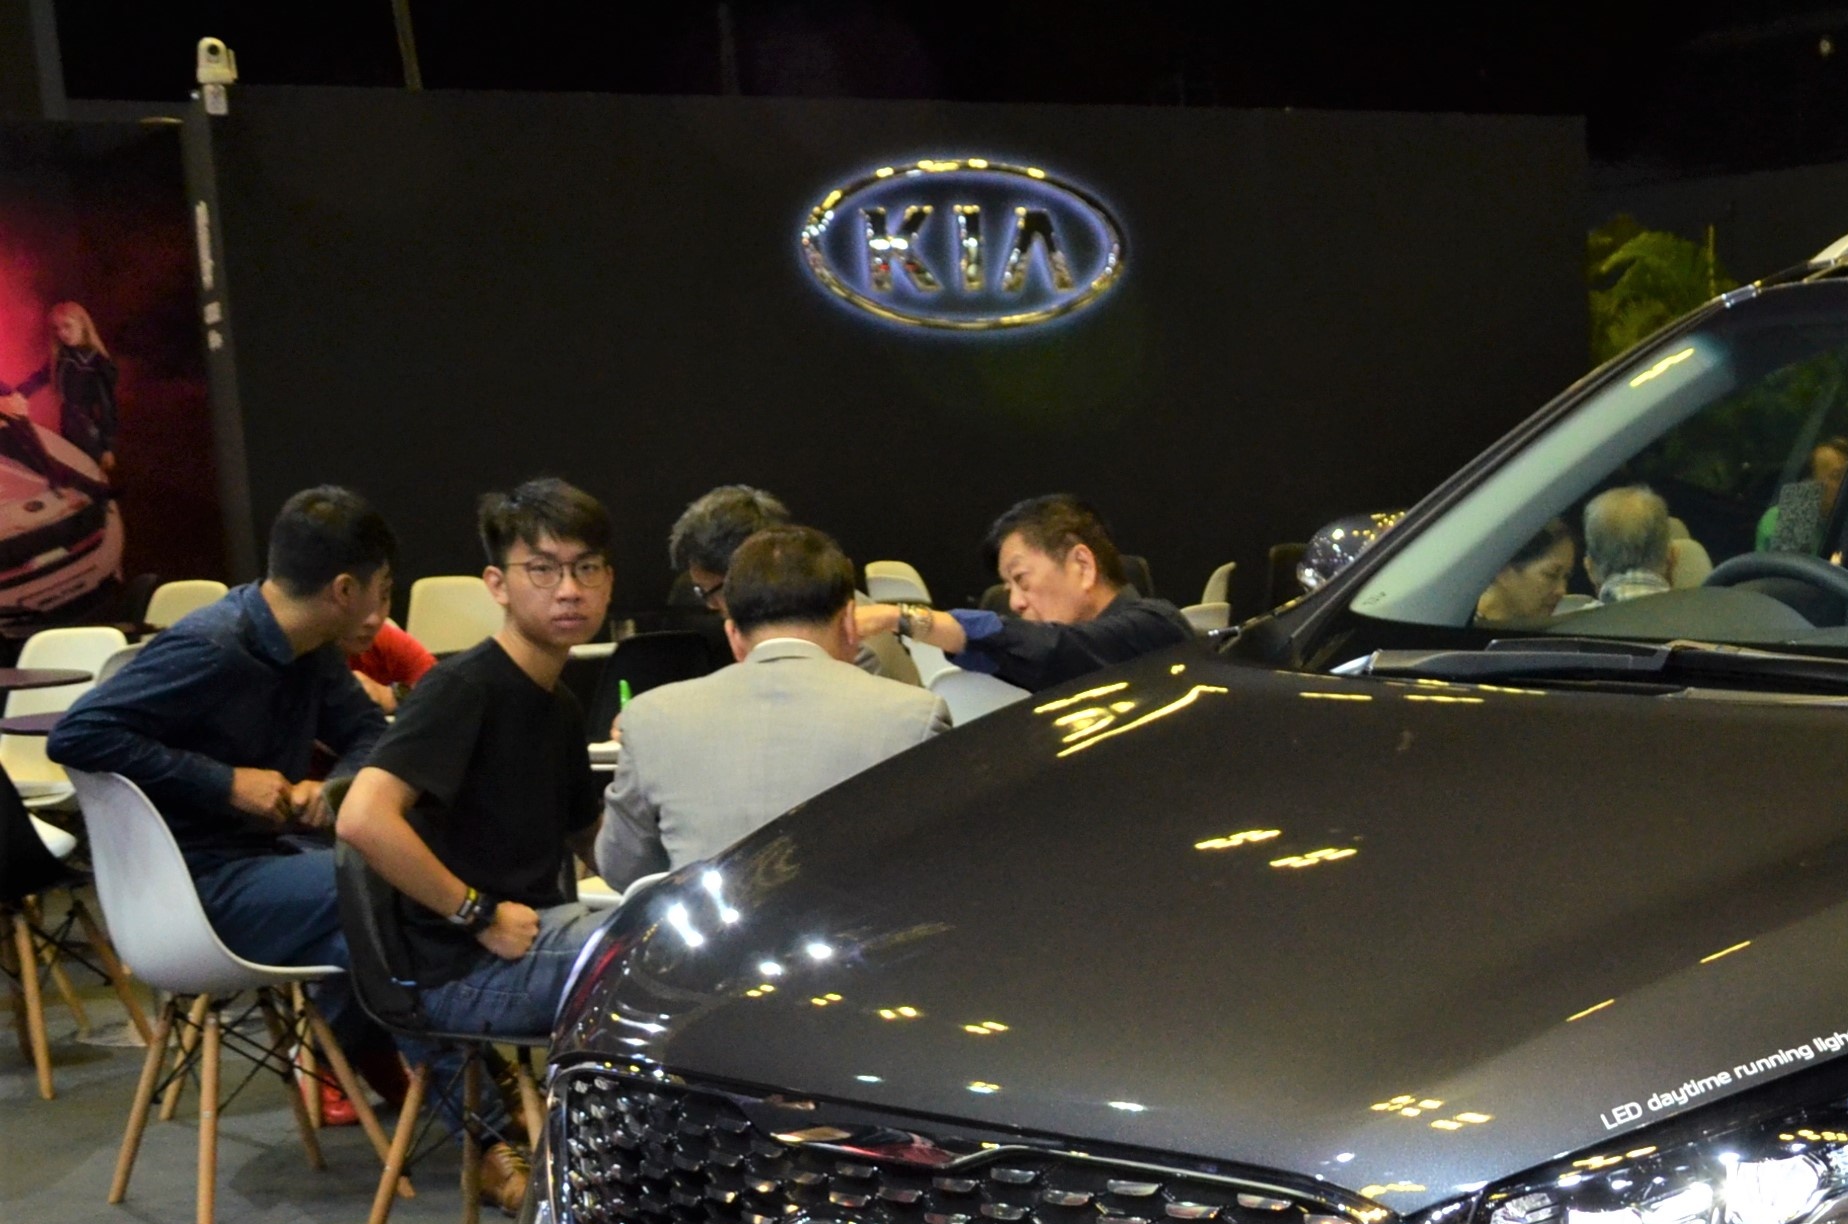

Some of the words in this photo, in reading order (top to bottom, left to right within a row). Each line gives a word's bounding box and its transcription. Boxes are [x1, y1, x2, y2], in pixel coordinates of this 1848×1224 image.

[857, 204, 1075, 294] KIA
[1600, 1101, 1643, 1130] LED
[1647, 1070, 1732, 1112] daytime
[1733, 1044, 1814, 1080] running
